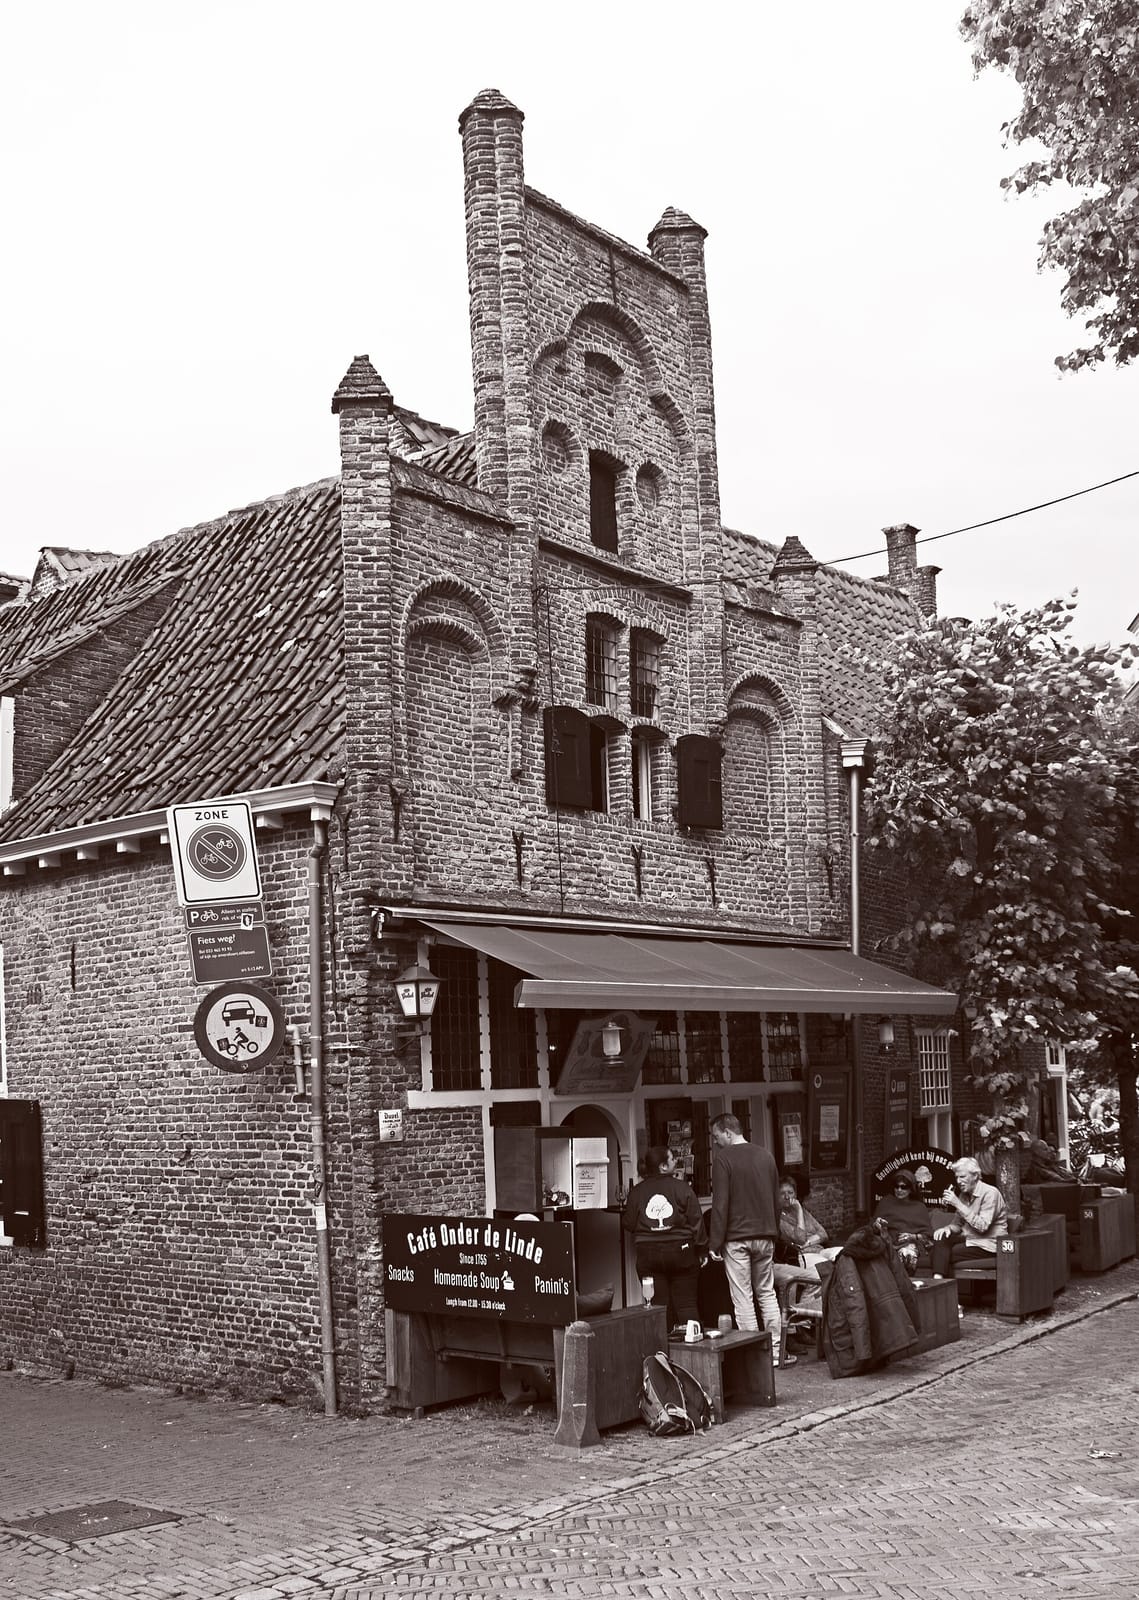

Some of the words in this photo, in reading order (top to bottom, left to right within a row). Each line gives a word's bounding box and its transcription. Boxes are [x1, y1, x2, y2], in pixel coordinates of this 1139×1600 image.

[195, 809, 229, 822] ZONE
[190, 911, 200, 923] P
[197, 936, 216, 945] Fiets
[909, 1150, 925, 1161] kent
[926, 1150, 936, 1163] bij
[935, 1154, 949, 1166] ons
[407, 1225, 437, 1255] Café
[440, 1221, 480, 1246] Onder
[484, 1223, 500, 1249] de
[505, 1228, 544, 1264] Linde
[1001, 1241, 1014, 1252] 30
[459, 1252, 474, 1265] Since
[475, 1253, 488, 1266] 1755
[388, 1264, 415, 1282] Snacks
[433, 1267, 478, 1289] Homemade
[480, 1271, 500, 1293] Soup
[535, 1275, 569, 1296] Panini's
